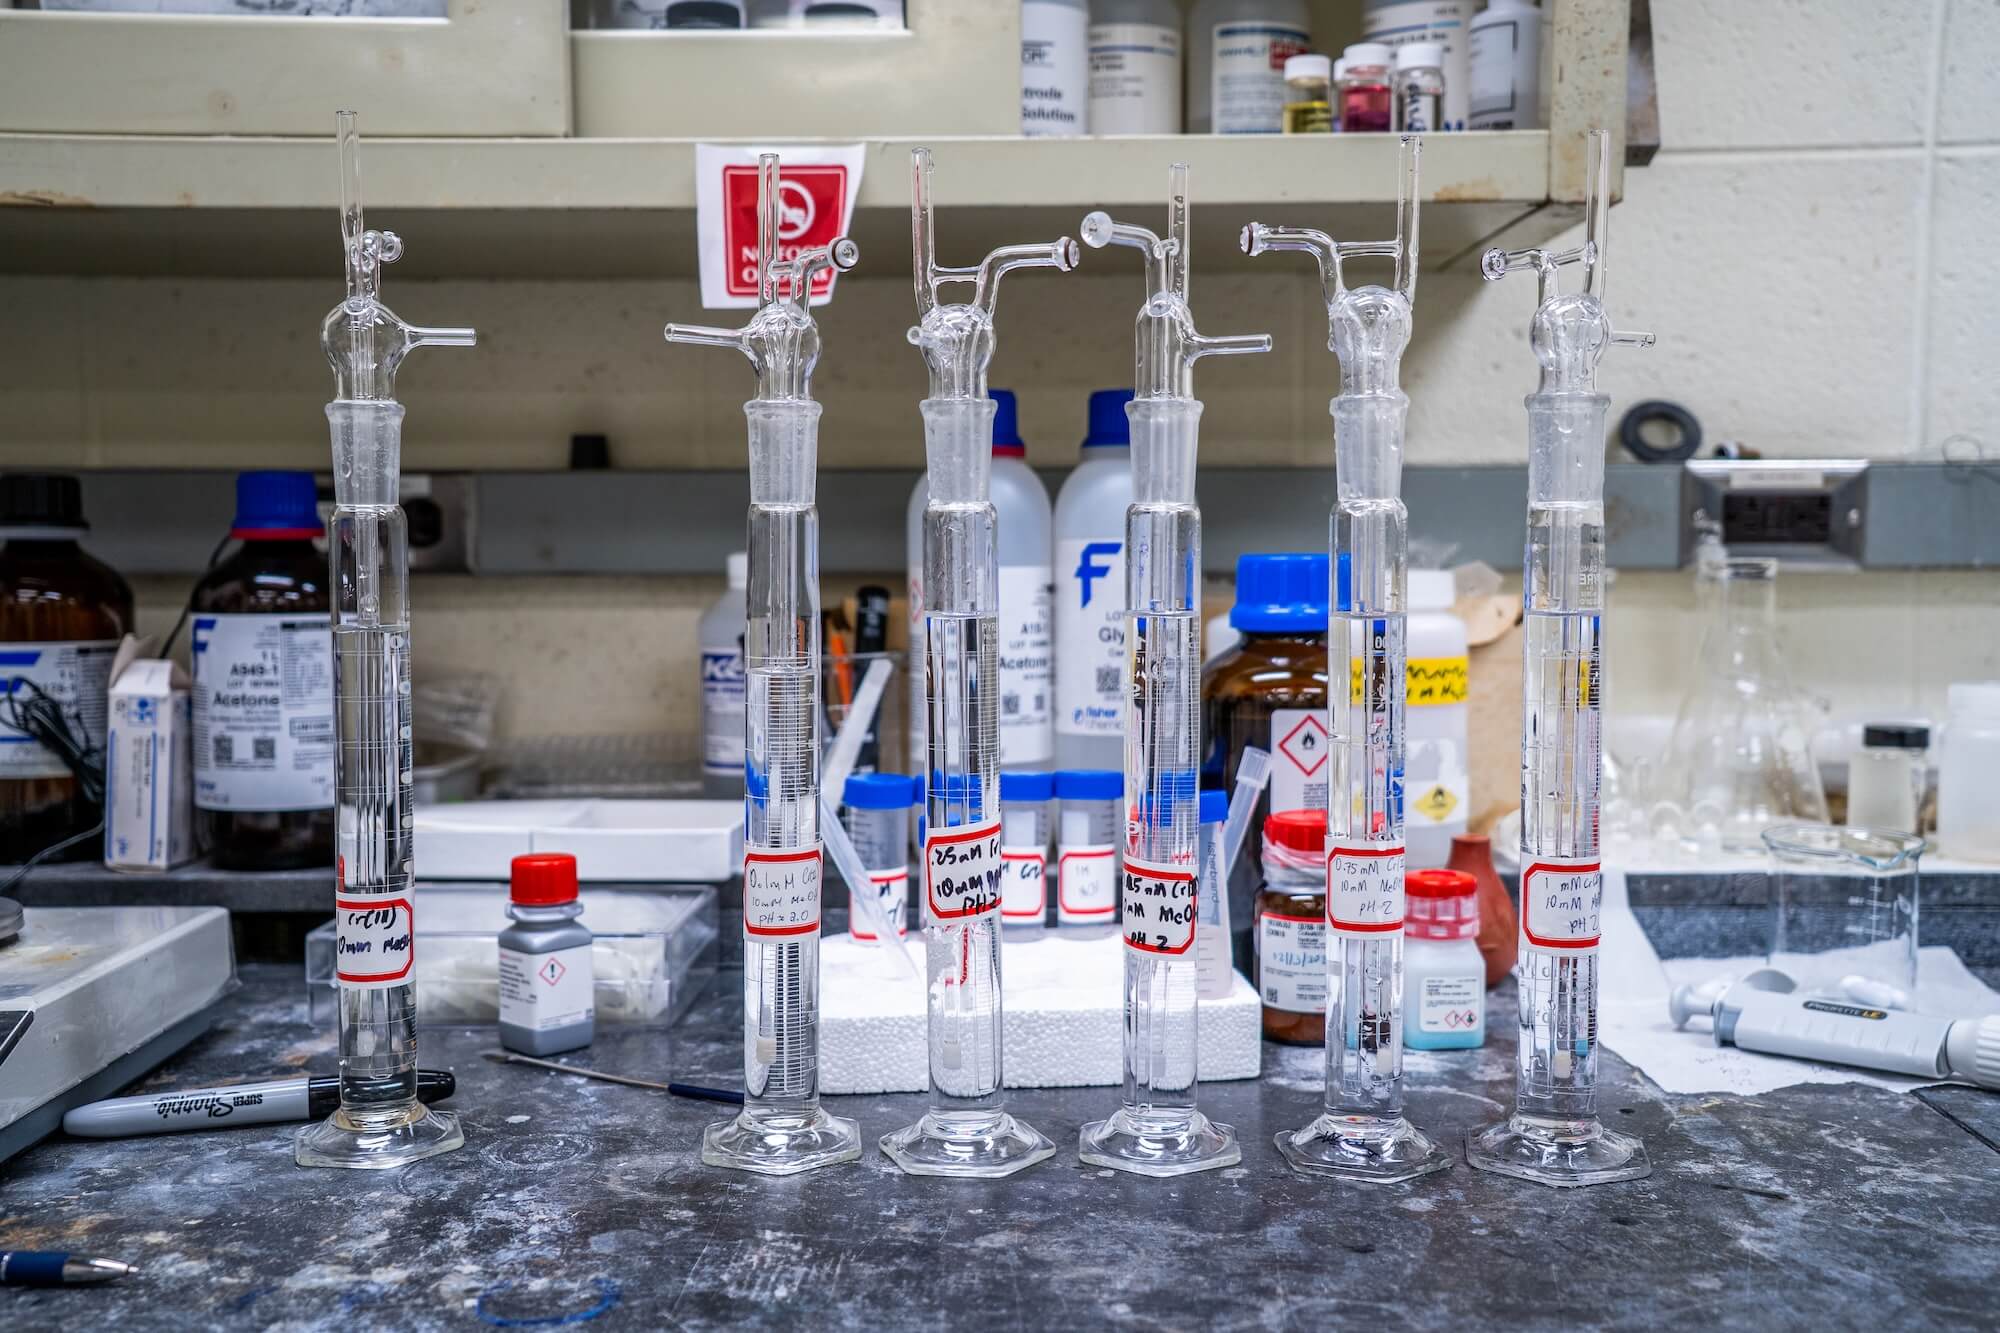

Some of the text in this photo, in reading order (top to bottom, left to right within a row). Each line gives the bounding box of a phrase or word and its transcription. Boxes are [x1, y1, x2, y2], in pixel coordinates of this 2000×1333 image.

[212, 692, 281, 708] Acetone
[1156, 935, 1171, 951] 2
[232, 1094, 263, 1107] SUPER
